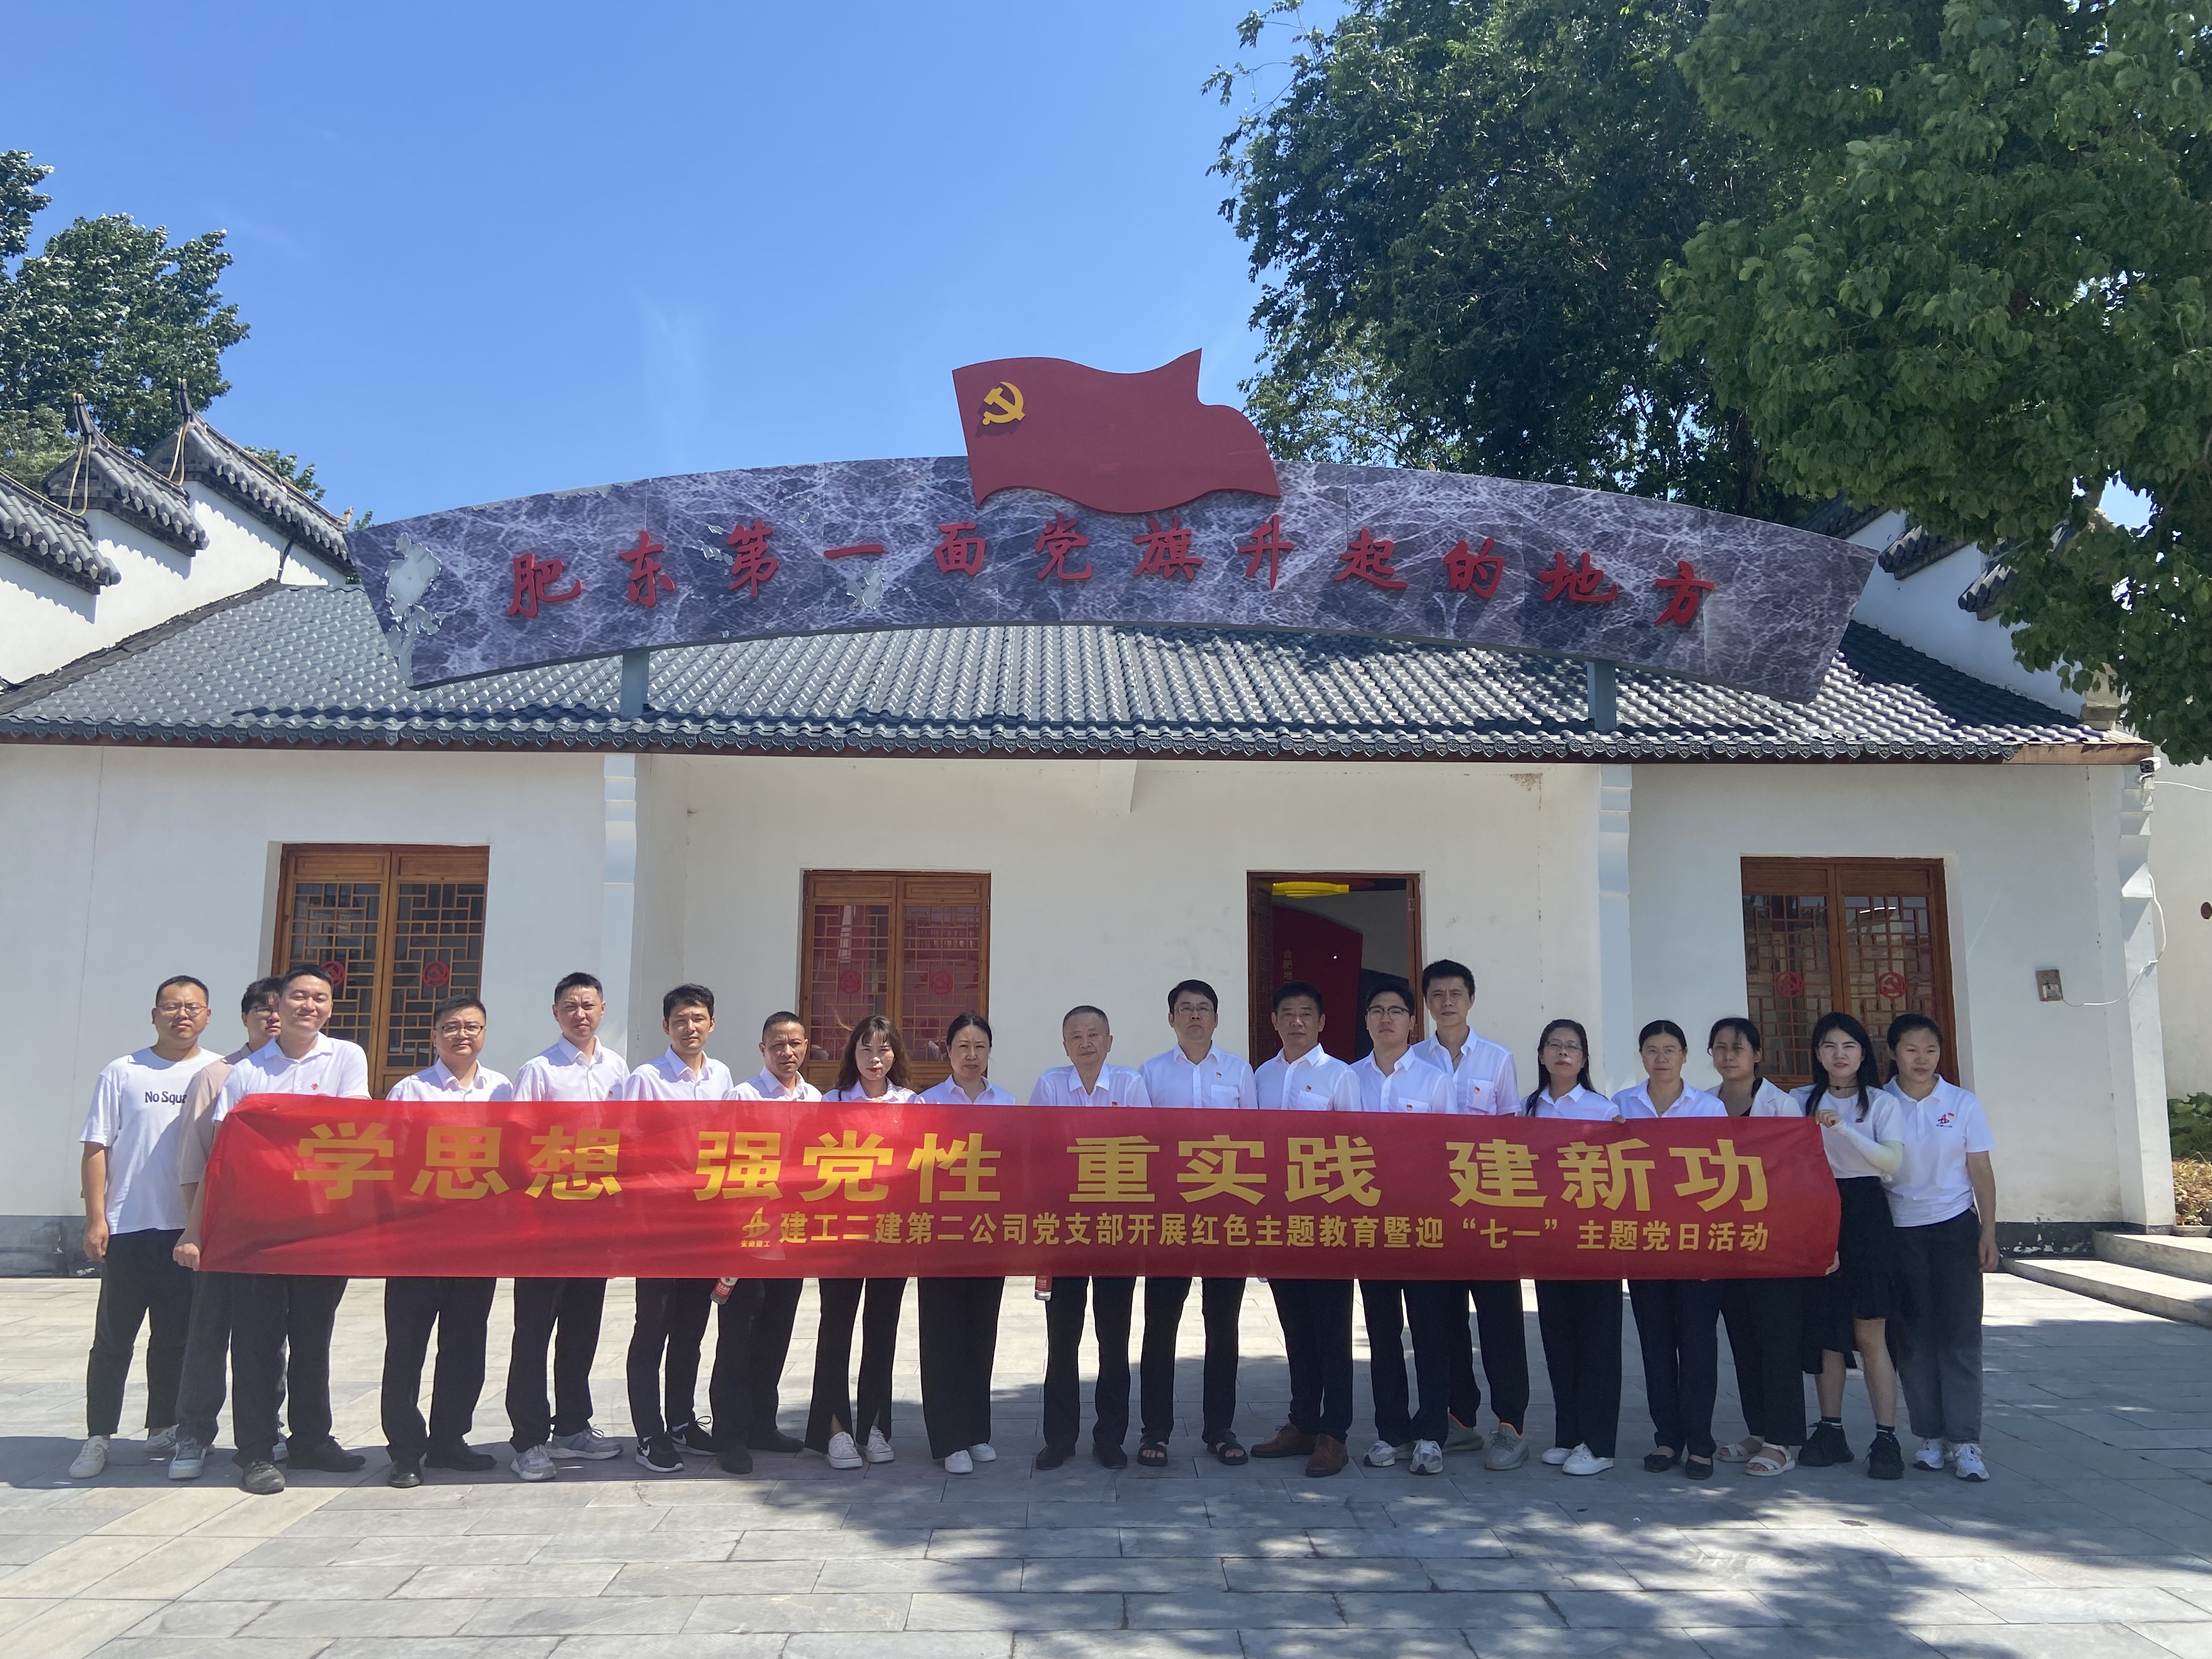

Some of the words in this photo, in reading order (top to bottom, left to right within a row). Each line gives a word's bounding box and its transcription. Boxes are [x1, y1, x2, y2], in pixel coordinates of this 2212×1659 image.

[507, 511, 1714, 626] 肥东第一面党旗升起的地方
[1283, 950, 1292, 984] 合肥地
[145, 1091, 159, 1103] No
[294, 1122, 622, 1200] 学思想
[693, 1130, 1001, 1203] 强党性
[1066, 1135, 1381, 1206] 重实践
[1446, 1138, 1768, 1212] 建新功
